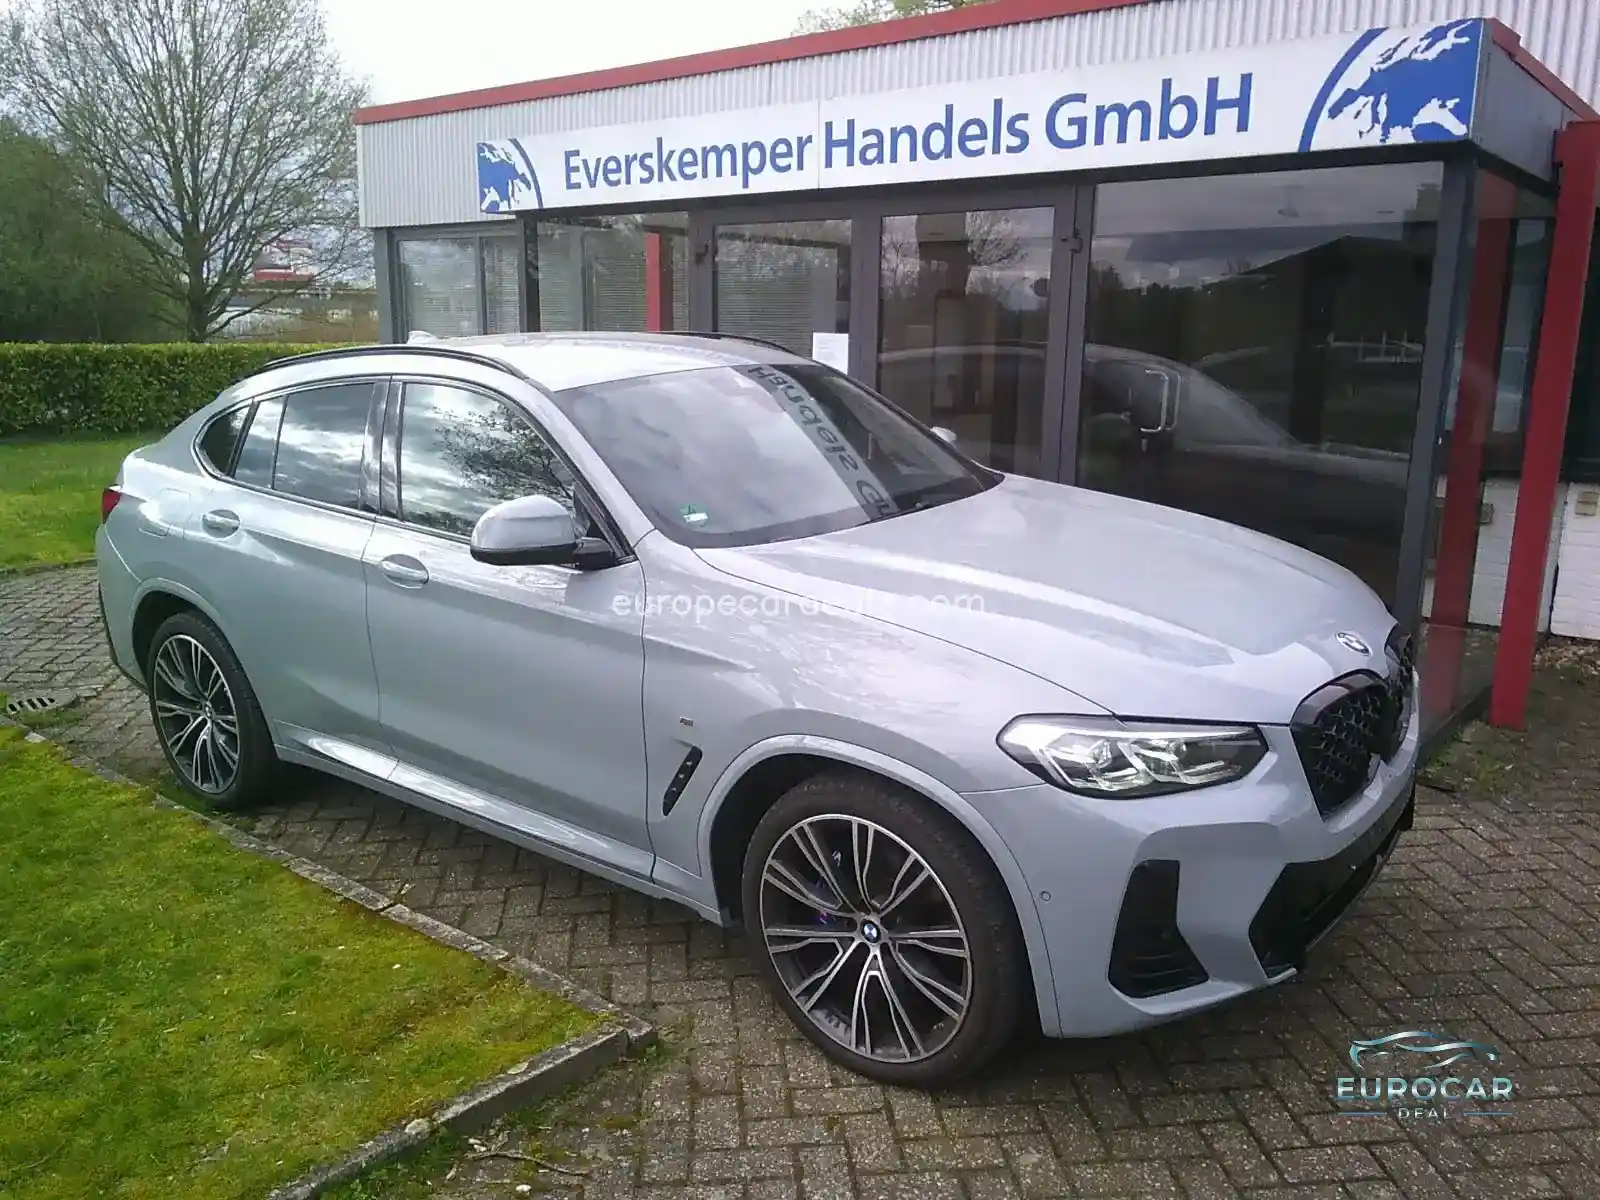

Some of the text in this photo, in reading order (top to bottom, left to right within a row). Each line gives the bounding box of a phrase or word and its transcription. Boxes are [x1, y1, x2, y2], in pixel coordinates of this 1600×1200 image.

[564, 71, 1254, 191] Everskemper Handels GmbH
